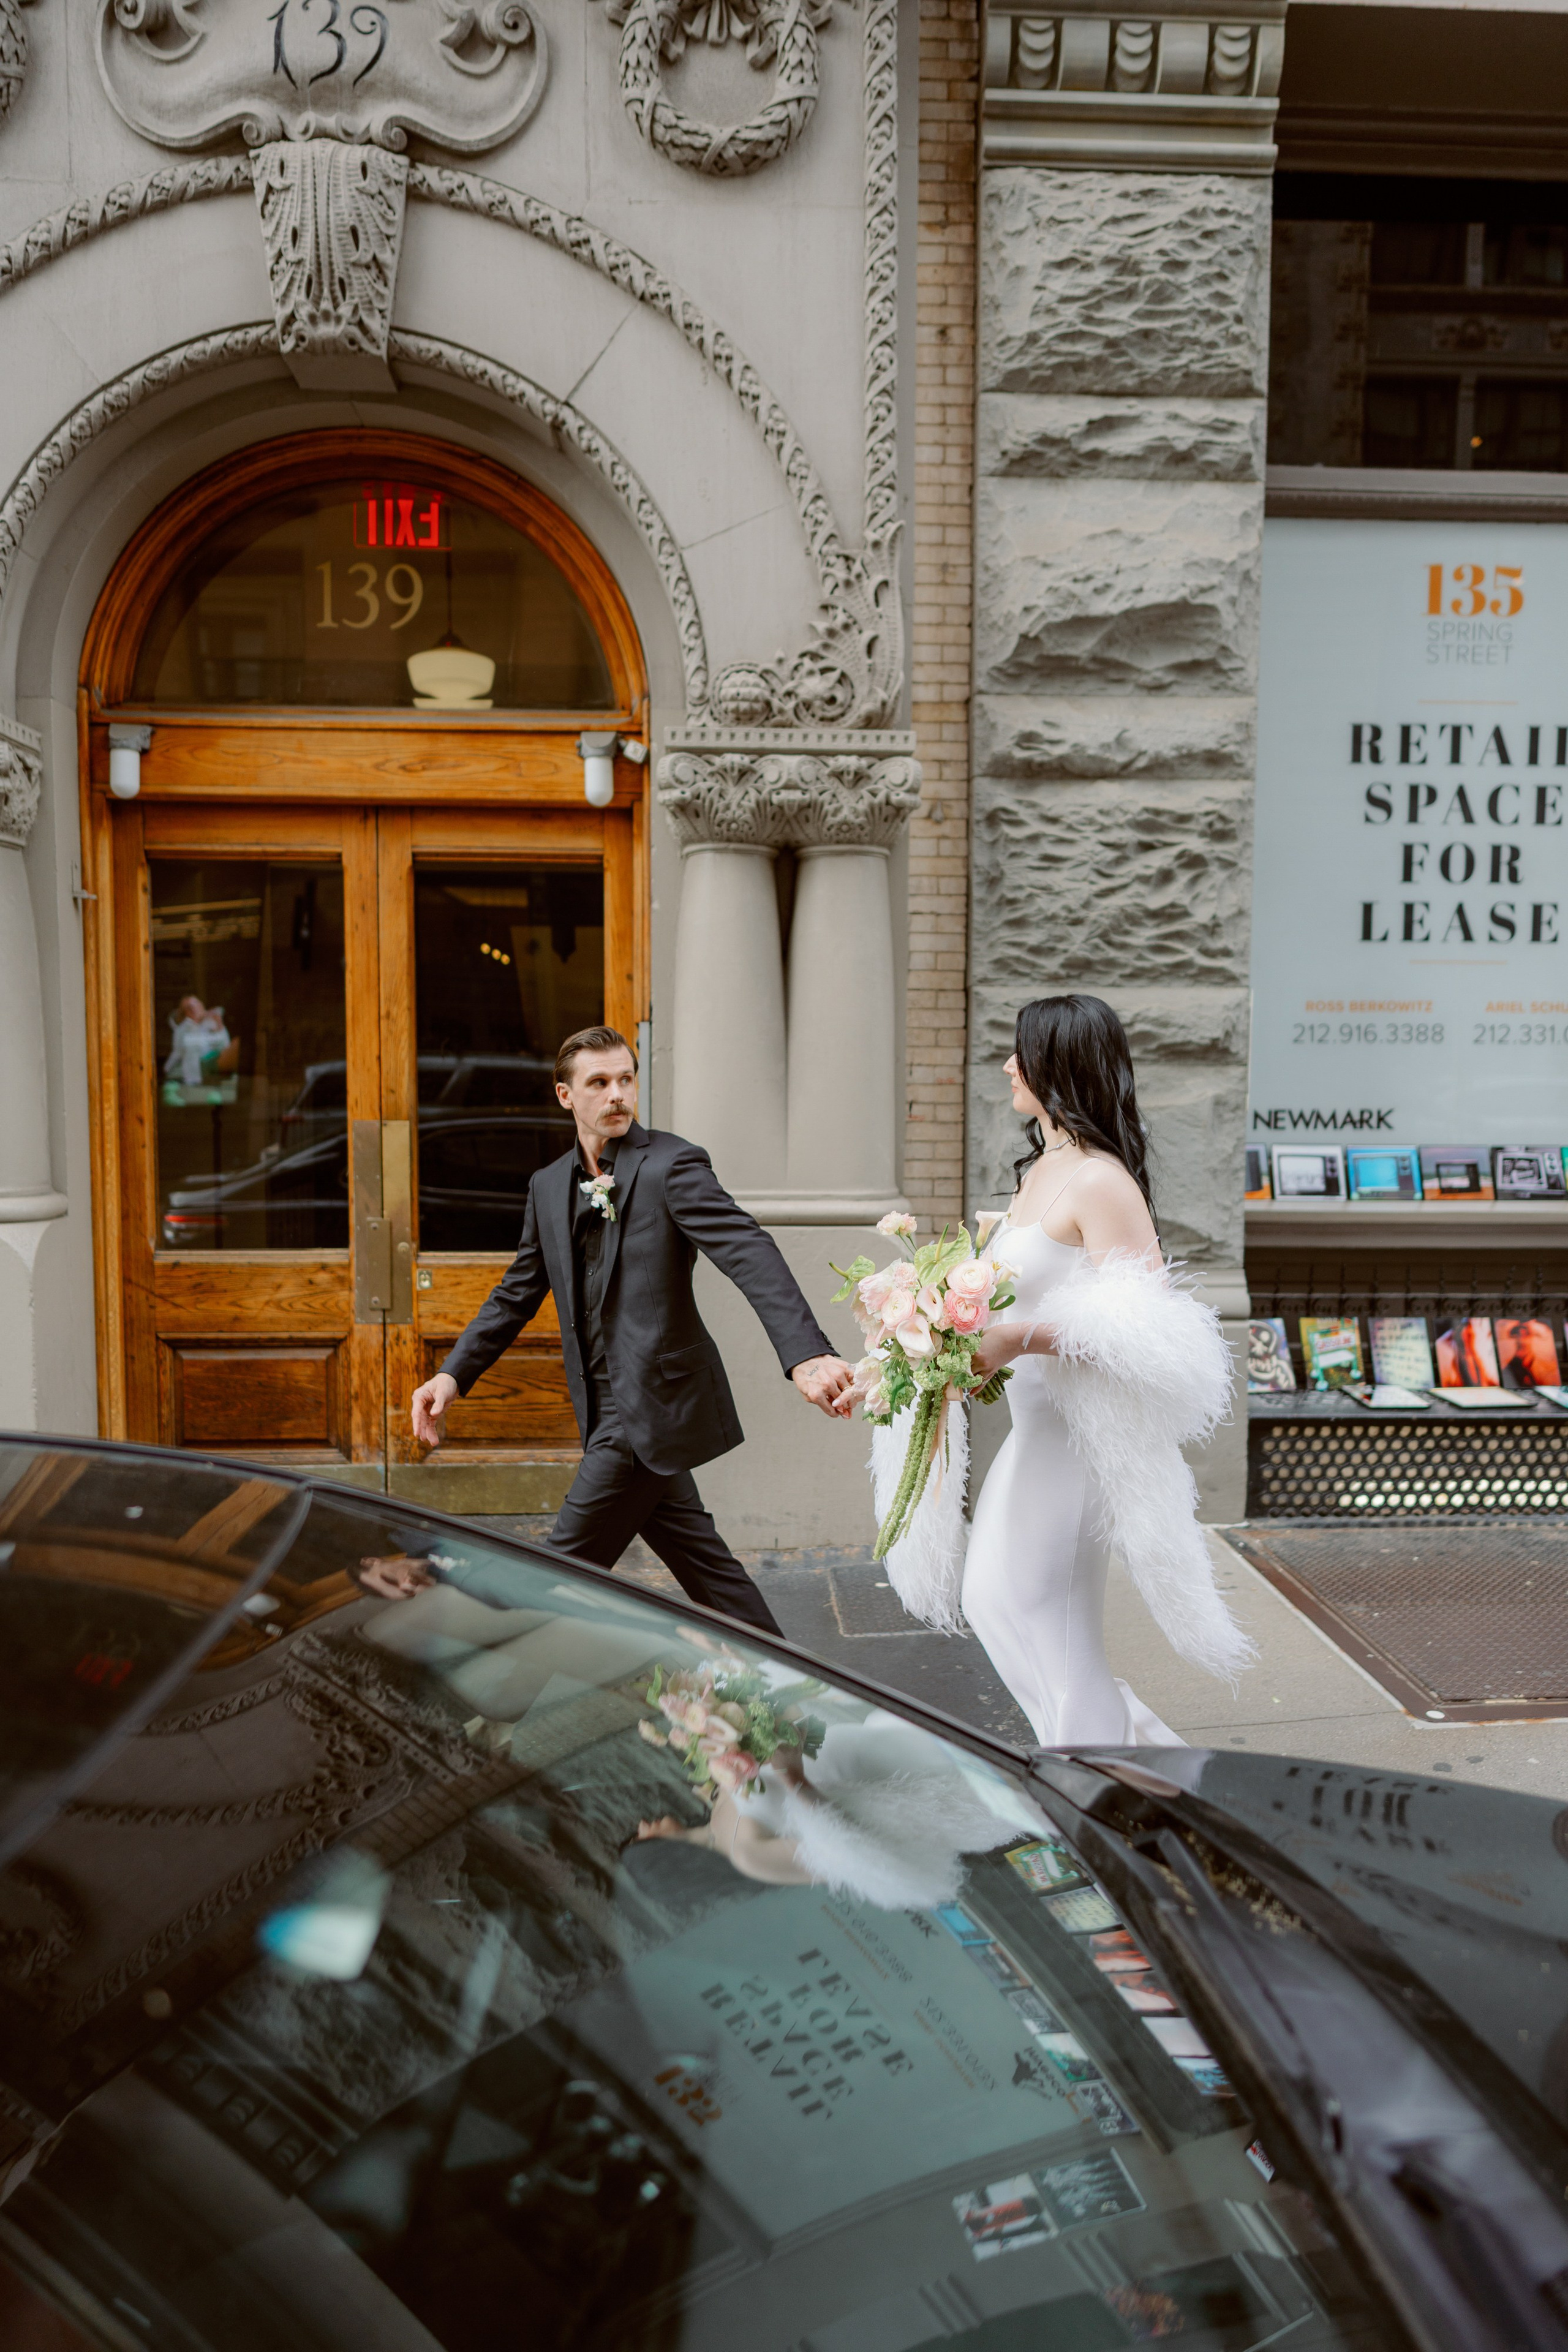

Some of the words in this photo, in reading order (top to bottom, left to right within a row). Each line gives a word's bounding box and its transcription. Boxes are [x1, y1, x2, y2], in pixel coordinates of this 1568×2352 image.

[267, 0, 389, 89] 139
[315, 560, 424, 630] 139
[1422, 562, 1525, 618] 135
[1427, 620, 1513, 644] SPRING
[1426, 643, 1513, 665] STREET
[1364, 782, 1563, 826] SPACE
[1400, 842, 1525, 885] FOR
[1359, 900, 1559, 944] LEASE
[1305, 1000, 1344, 1014] ROSS
[1349, 1000, 1433, 1014] BERKOWITZ
[1485, 1000, 1525, 1014] ARIEL
[1292, 1022, 1445, 1044] 212.916.3388
[1253, 1109, 1395, 1131] NEWMARK
